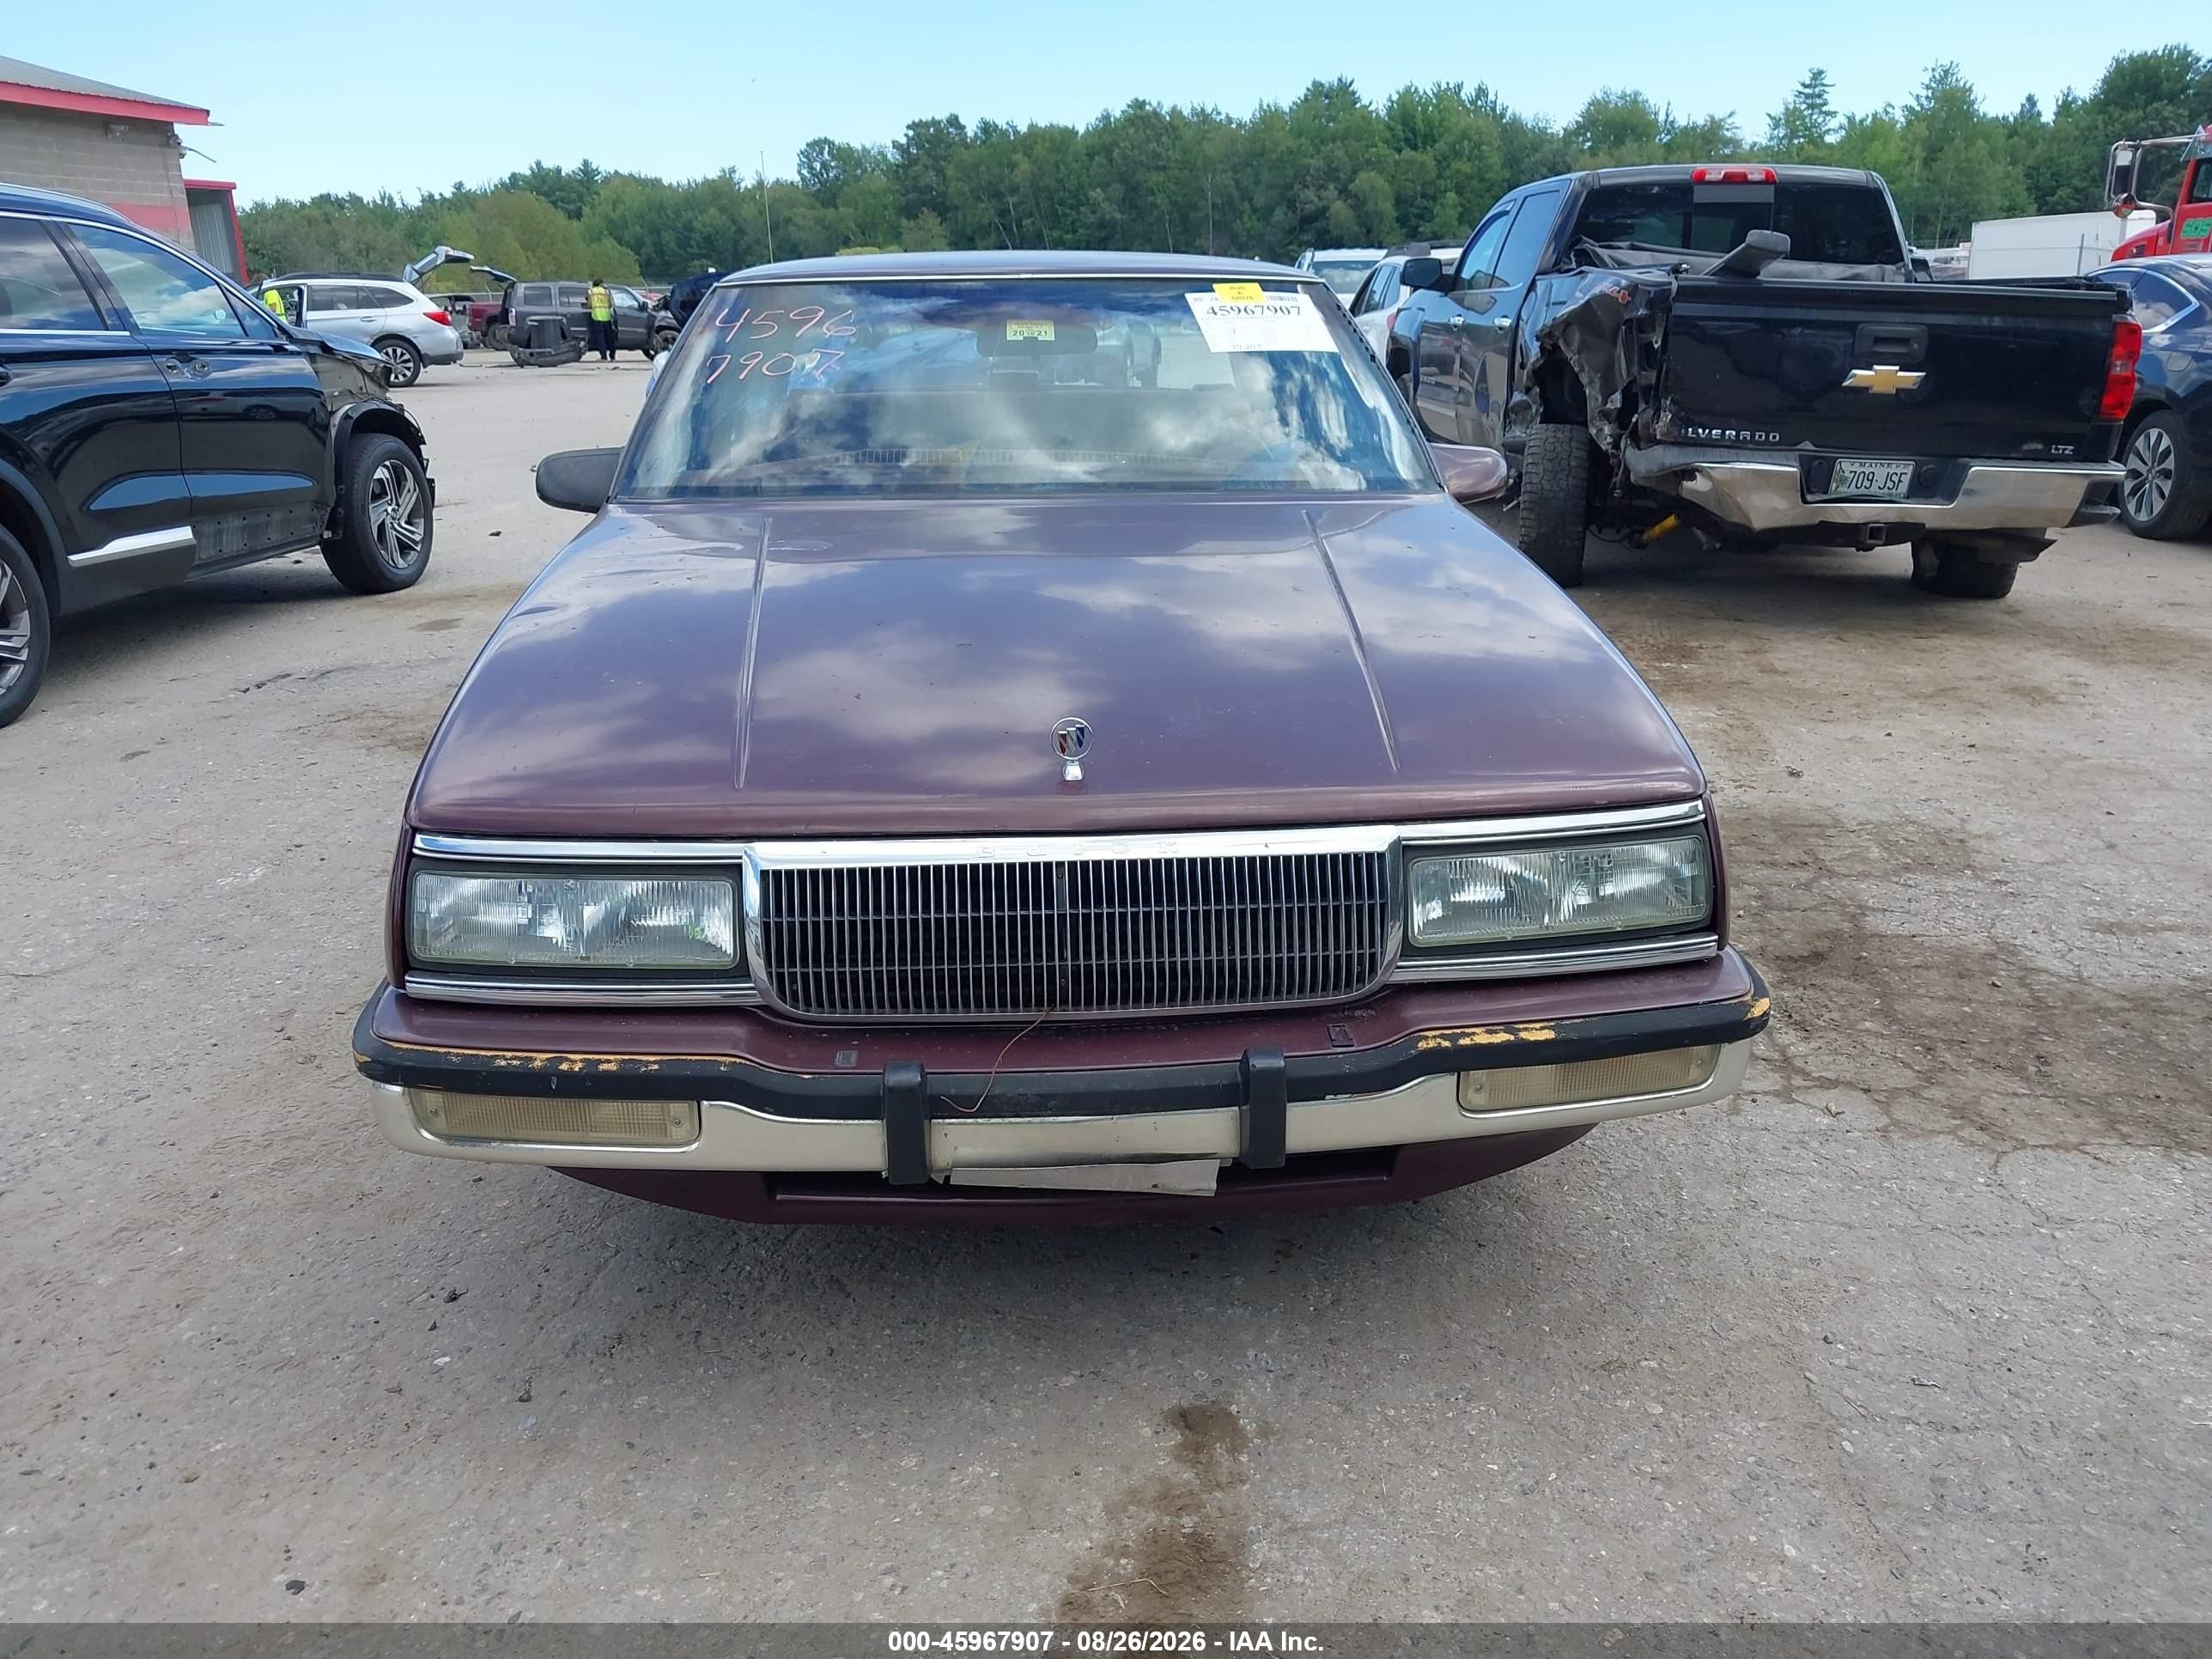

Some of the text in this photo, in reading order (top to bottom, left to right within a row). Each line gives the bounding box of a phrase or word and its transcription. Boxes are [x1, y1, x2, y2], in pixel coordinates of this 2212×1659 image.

[1206, 305, 1300, 316] 45967907
[715, 306, 856, 343] 4596
[706, 348, 845, 384] 7907
[2051, 445, 2075, 455] LTZ
[975, 841, 1180, 859] BUICK
